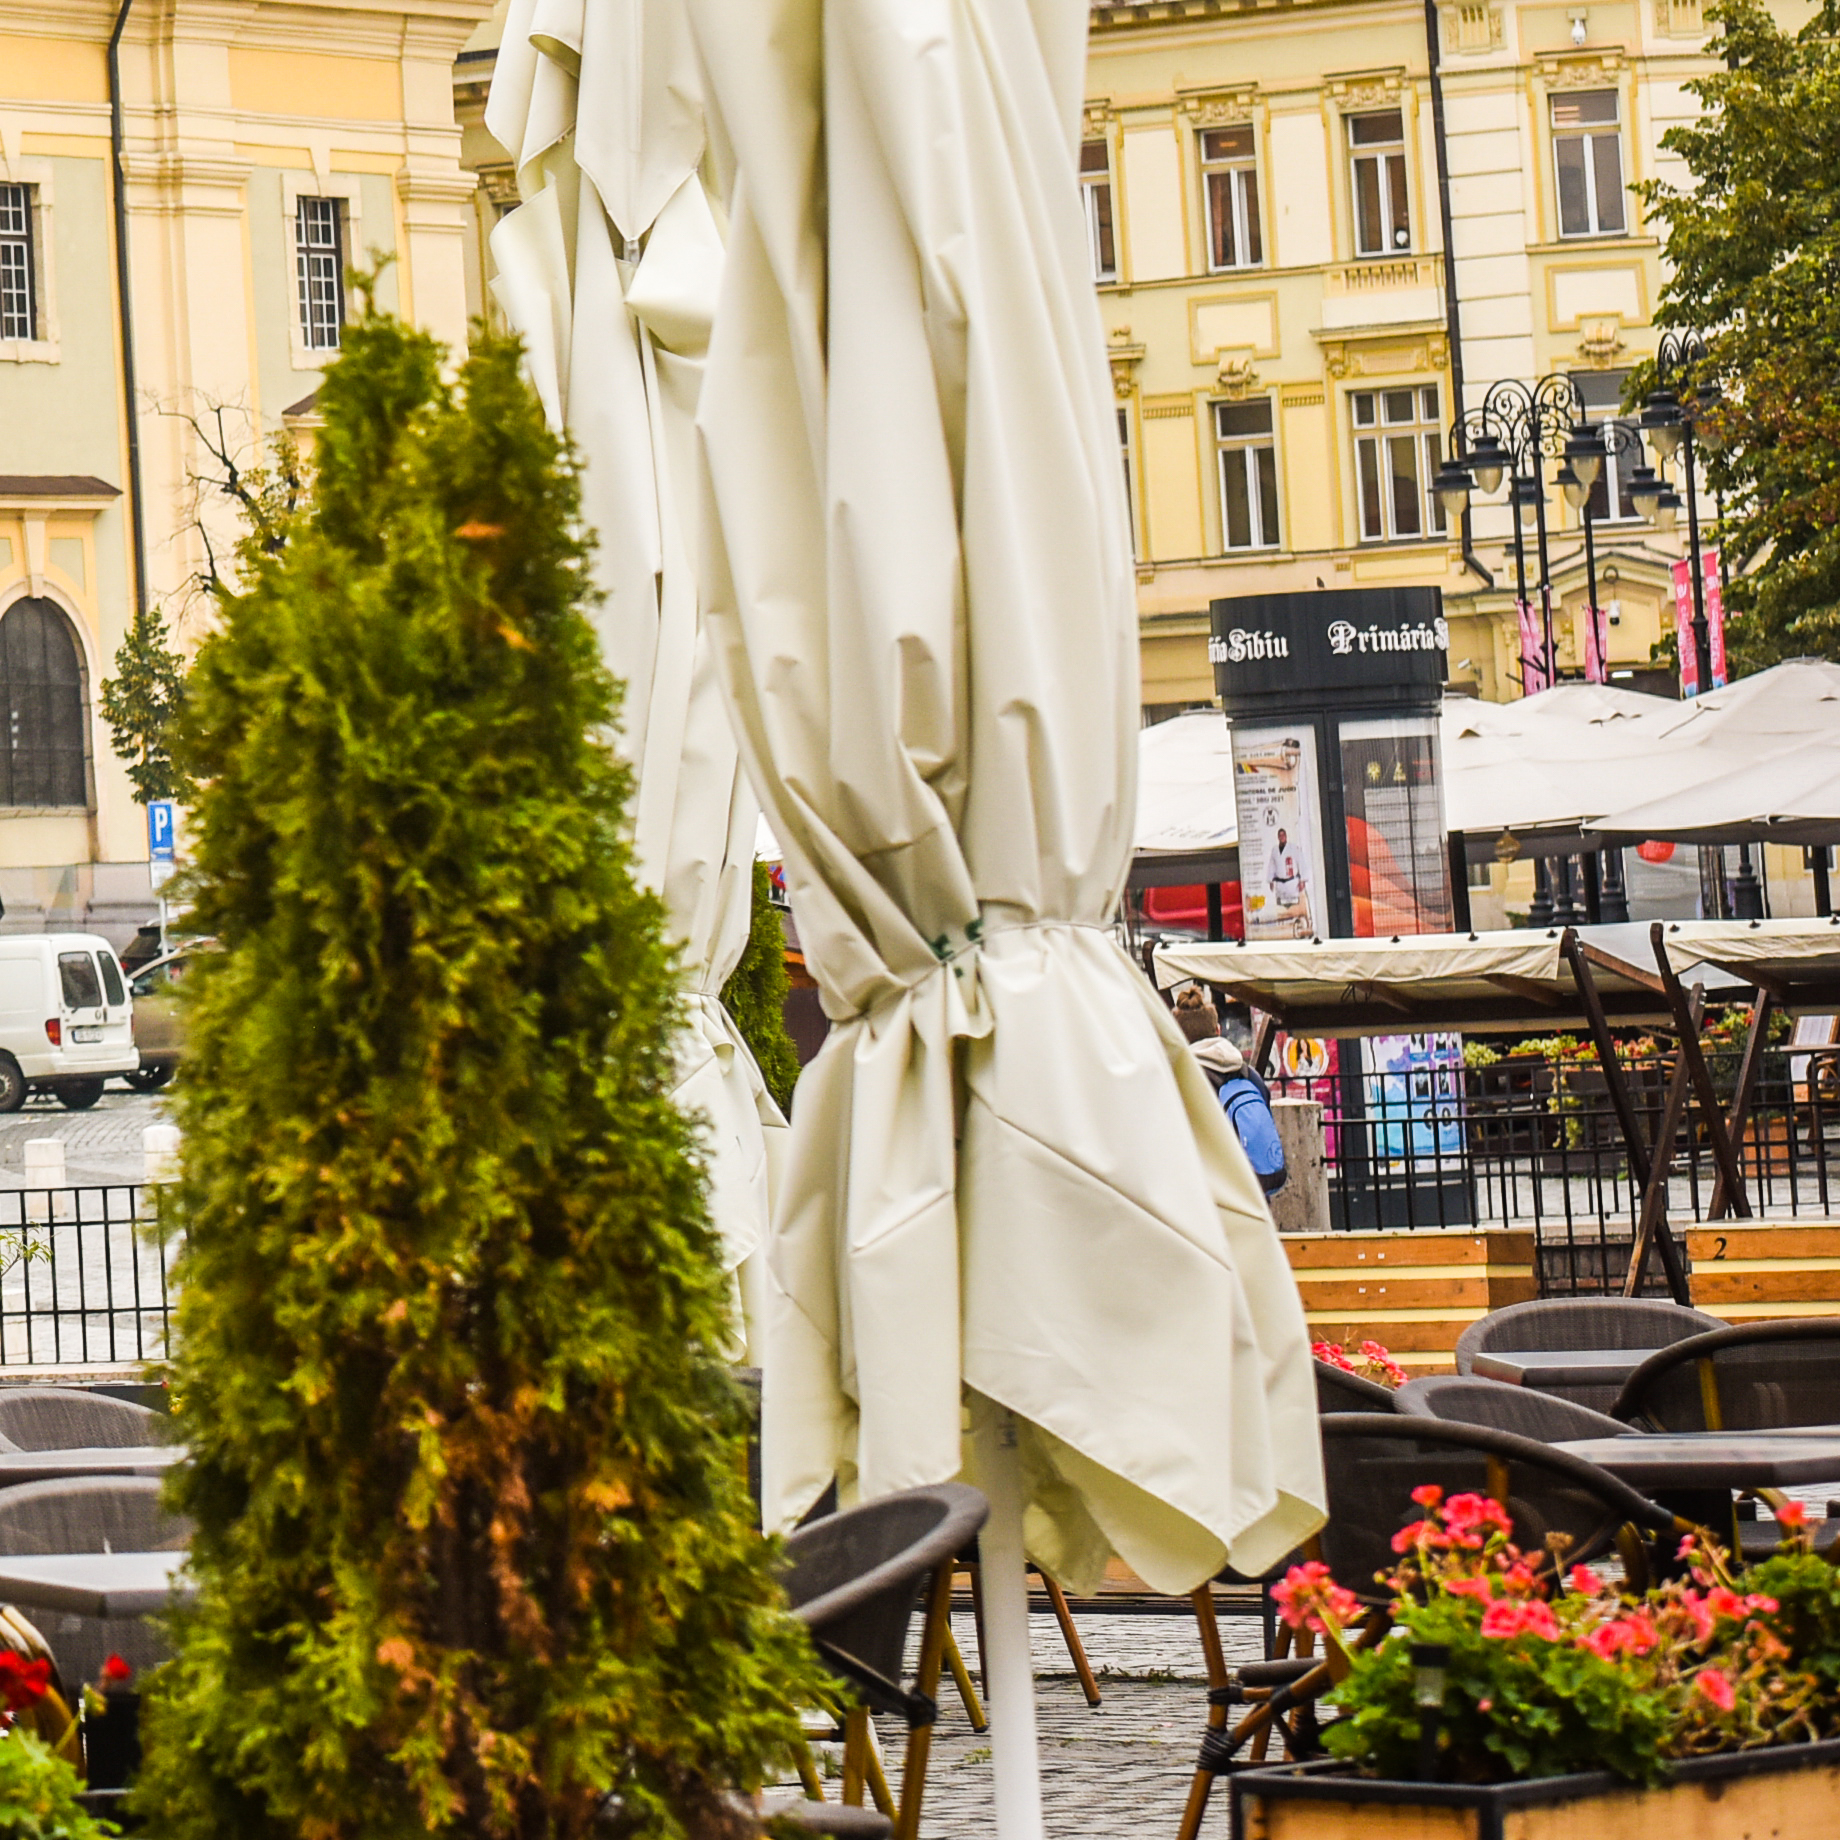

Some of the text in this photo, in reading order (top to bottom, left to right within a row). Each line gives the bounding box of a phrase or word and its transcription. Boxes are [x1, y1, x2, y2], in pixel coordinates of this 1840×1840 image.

[1228, 628, 1289, 662] Sibiu
[154, 807, 168, 842] P
[1712, 1237, 1727, 1261] 2
